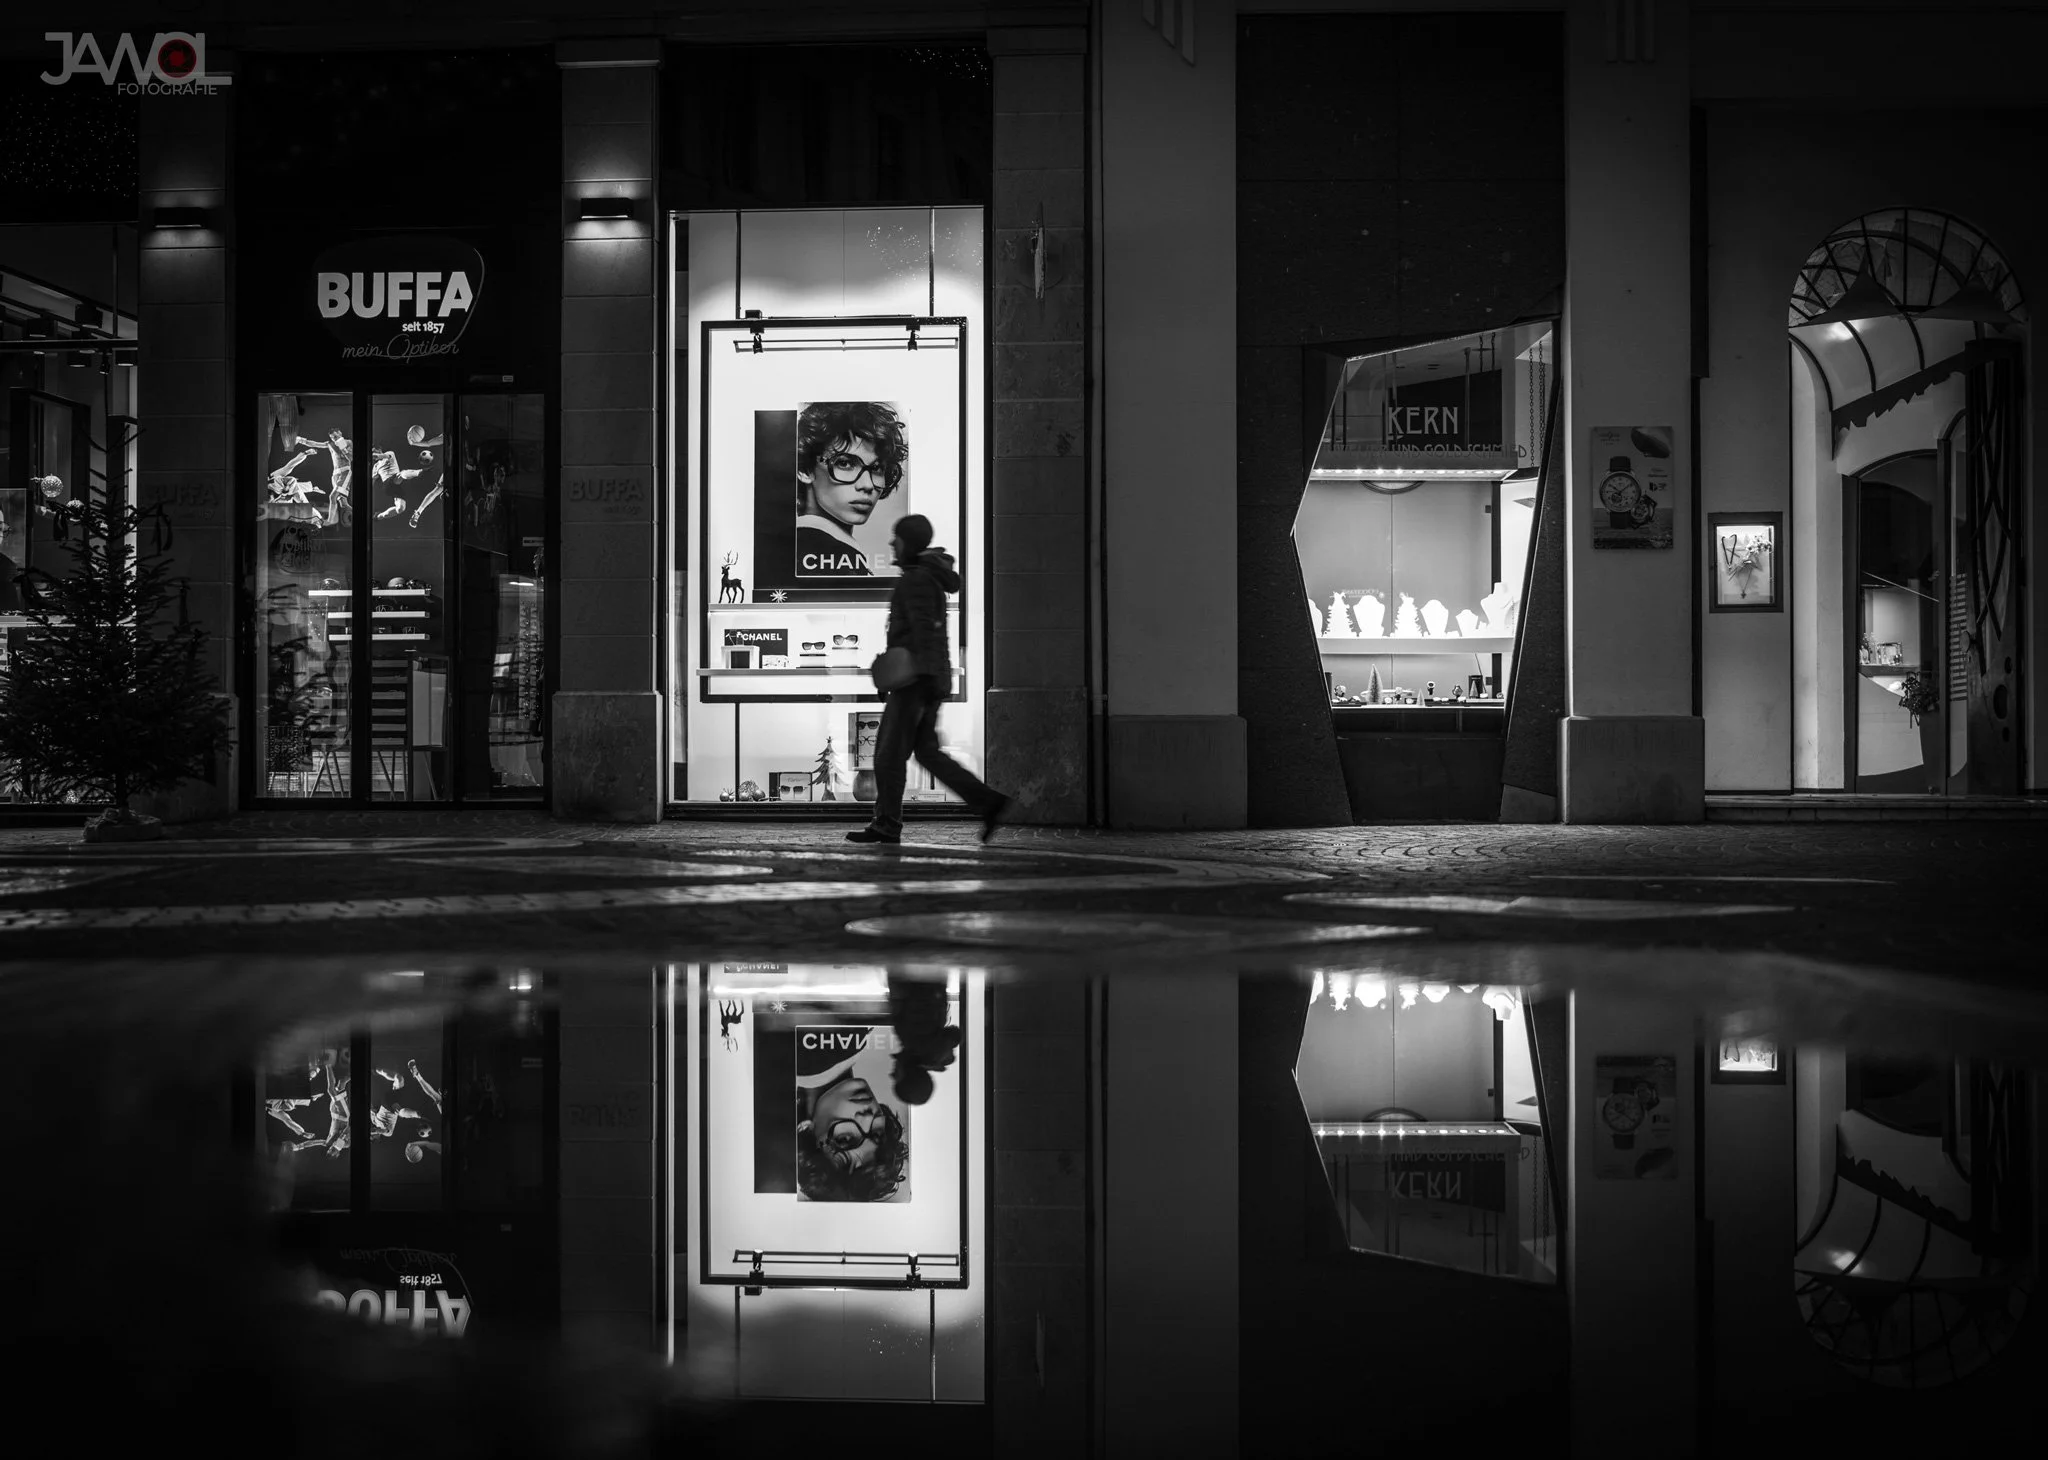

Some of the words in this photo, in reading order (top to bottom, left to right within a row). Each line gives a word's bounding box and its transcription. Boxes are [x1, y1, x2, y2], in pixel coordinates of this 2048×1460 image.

[317, 271, 474, 319] BUFFA
[402, 321, 421, 332] seit
[422, 321, 445, 334] 1857
[342, 343, 383, 359] mein
[386, 333, 460, 364] Optiker
[1387, 406, 1459, 435] KERN
[569, 478, 645, 502] BUFFA
[742, 632, 783, 641] CHANEL
